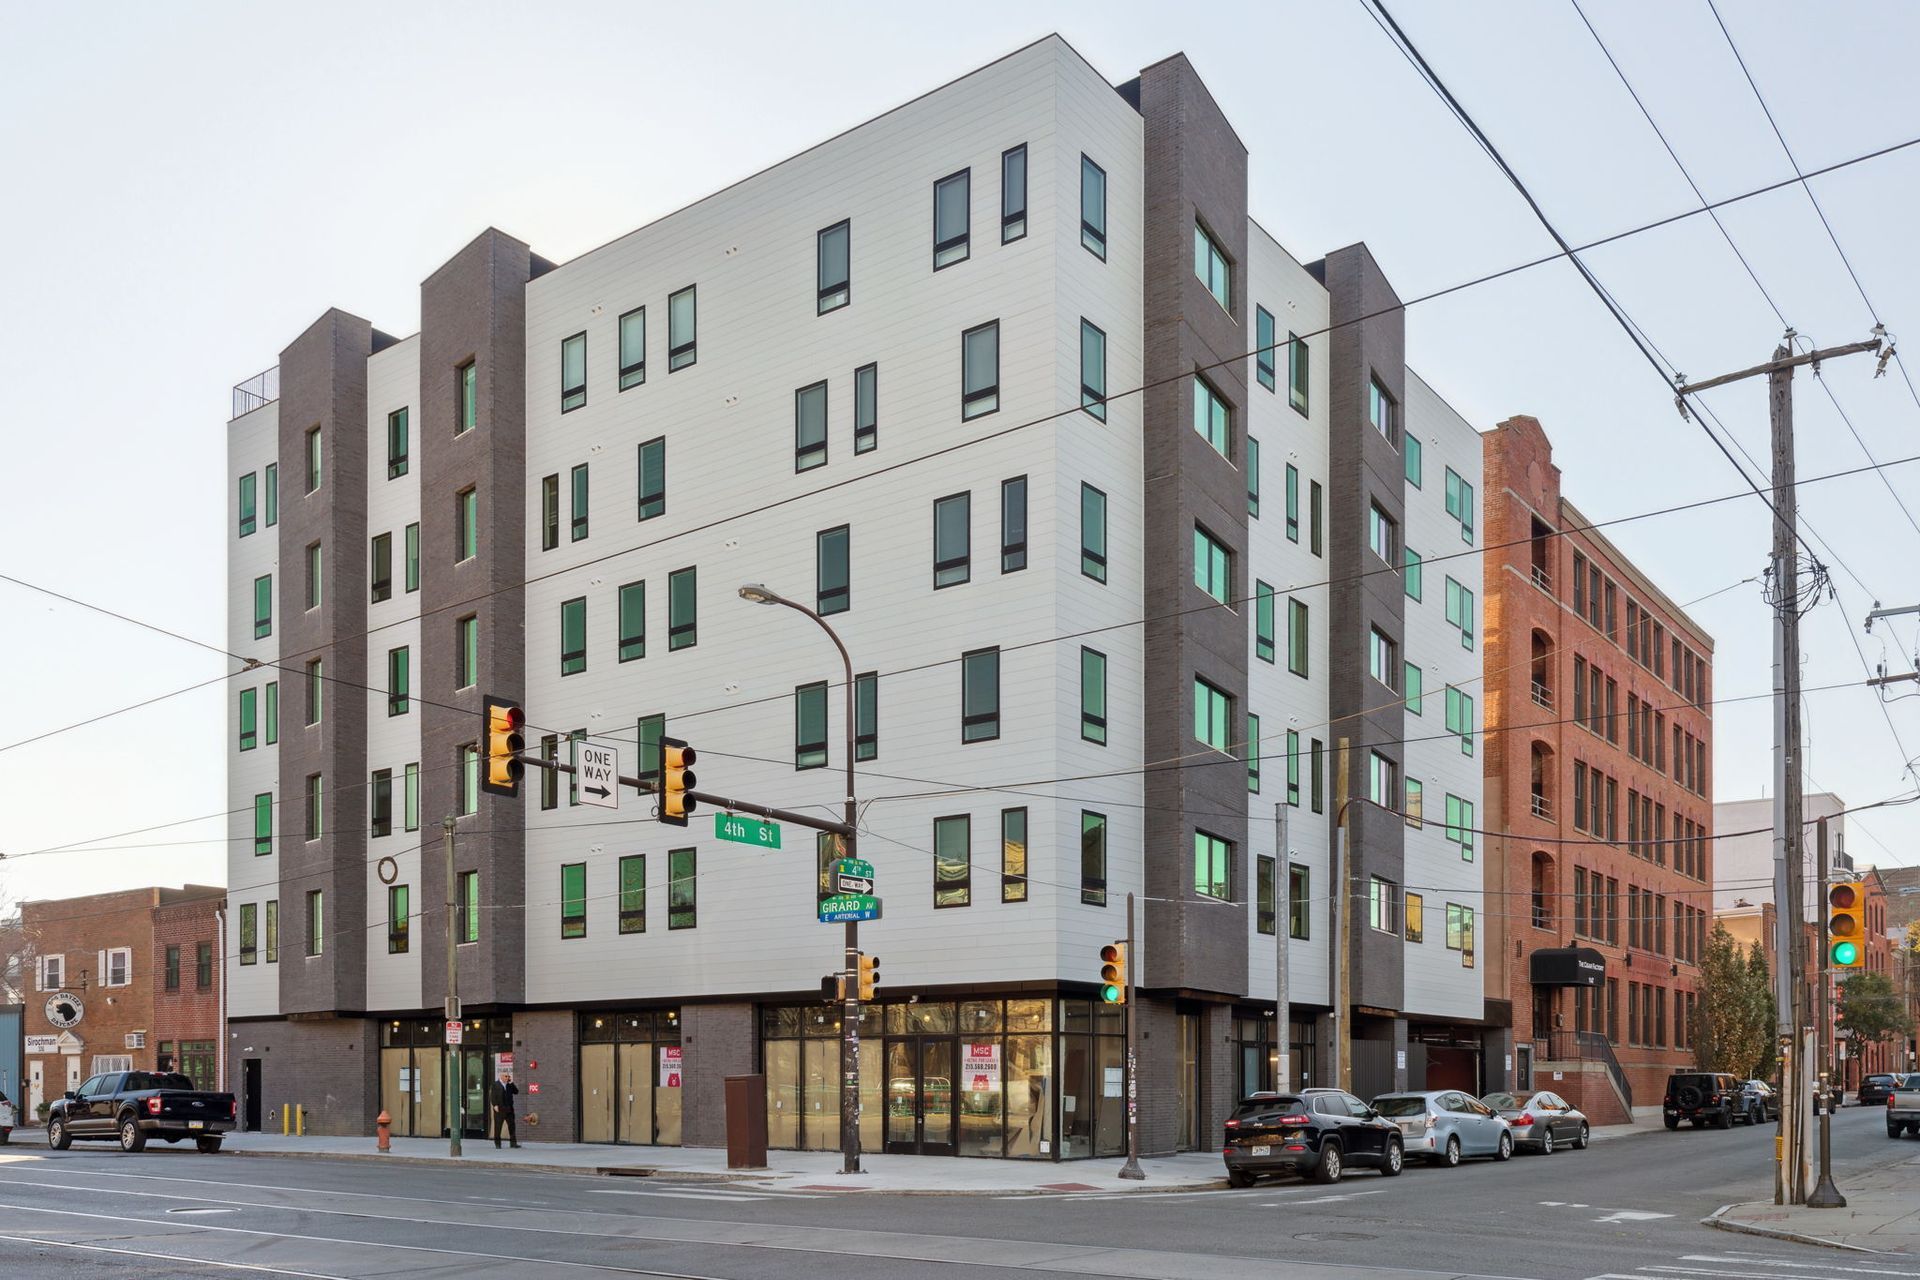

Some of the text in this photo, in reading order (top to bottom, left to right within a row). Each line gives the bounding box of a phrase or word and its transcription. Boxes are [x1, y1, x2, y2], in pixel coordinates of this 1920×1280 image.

[584, 749, 611, 766] ONE
[584, 765, 611, 782] WAY
[724, 821, 773, 842] 4th St
[865, 870, 872, 878] ST
[822, 900, 874, 913] GIRARD AV
[864, 910, 871, 918] W
[668, 1049, 681, 1057] MSC
[973, 1047, 990, 1055] MSC
[529, 1084, 539, 1092] FDC
